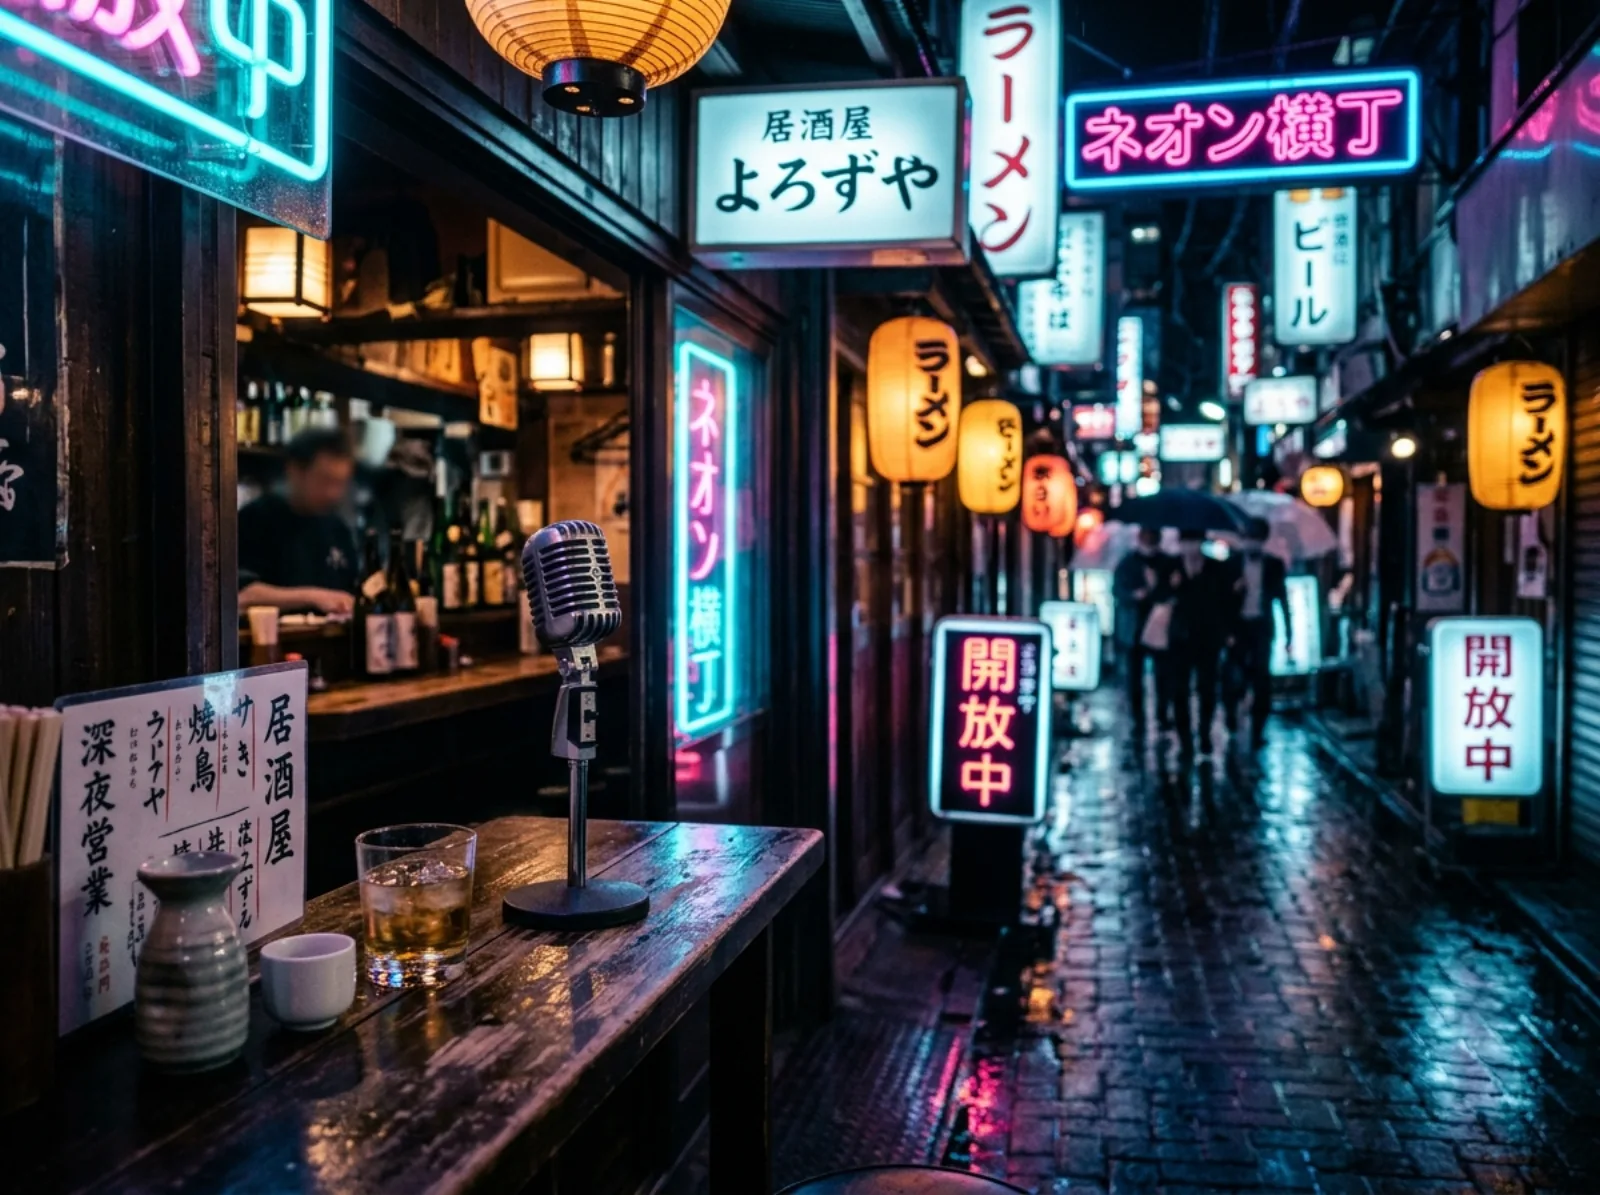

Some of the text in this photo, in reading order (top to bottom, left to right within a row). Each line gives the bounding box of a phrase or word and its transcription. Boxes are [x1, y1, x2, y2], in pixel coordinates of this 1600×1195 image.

[762, 105, 874, 144] 居酒屋
[979, 4, 1034, 254] ラーメン
[1081, 88, 1404, 172] ネオン横丁
[715, 149, 939, 213] よろずや
[1290, 216, 1329, 328] ビール
[915, 339, 950, 451] ラーメン
[1519, 380, 1556, 486] ラーメン
[187, 698, 217, 793] 焼鳥
[958, 636, 1017, 808] 開放中
[1463, 634, 1514, 783] 開放中
[80, 719, 117, 916] 深夜営業
[264, 693, 295, 867] 居酒屋
